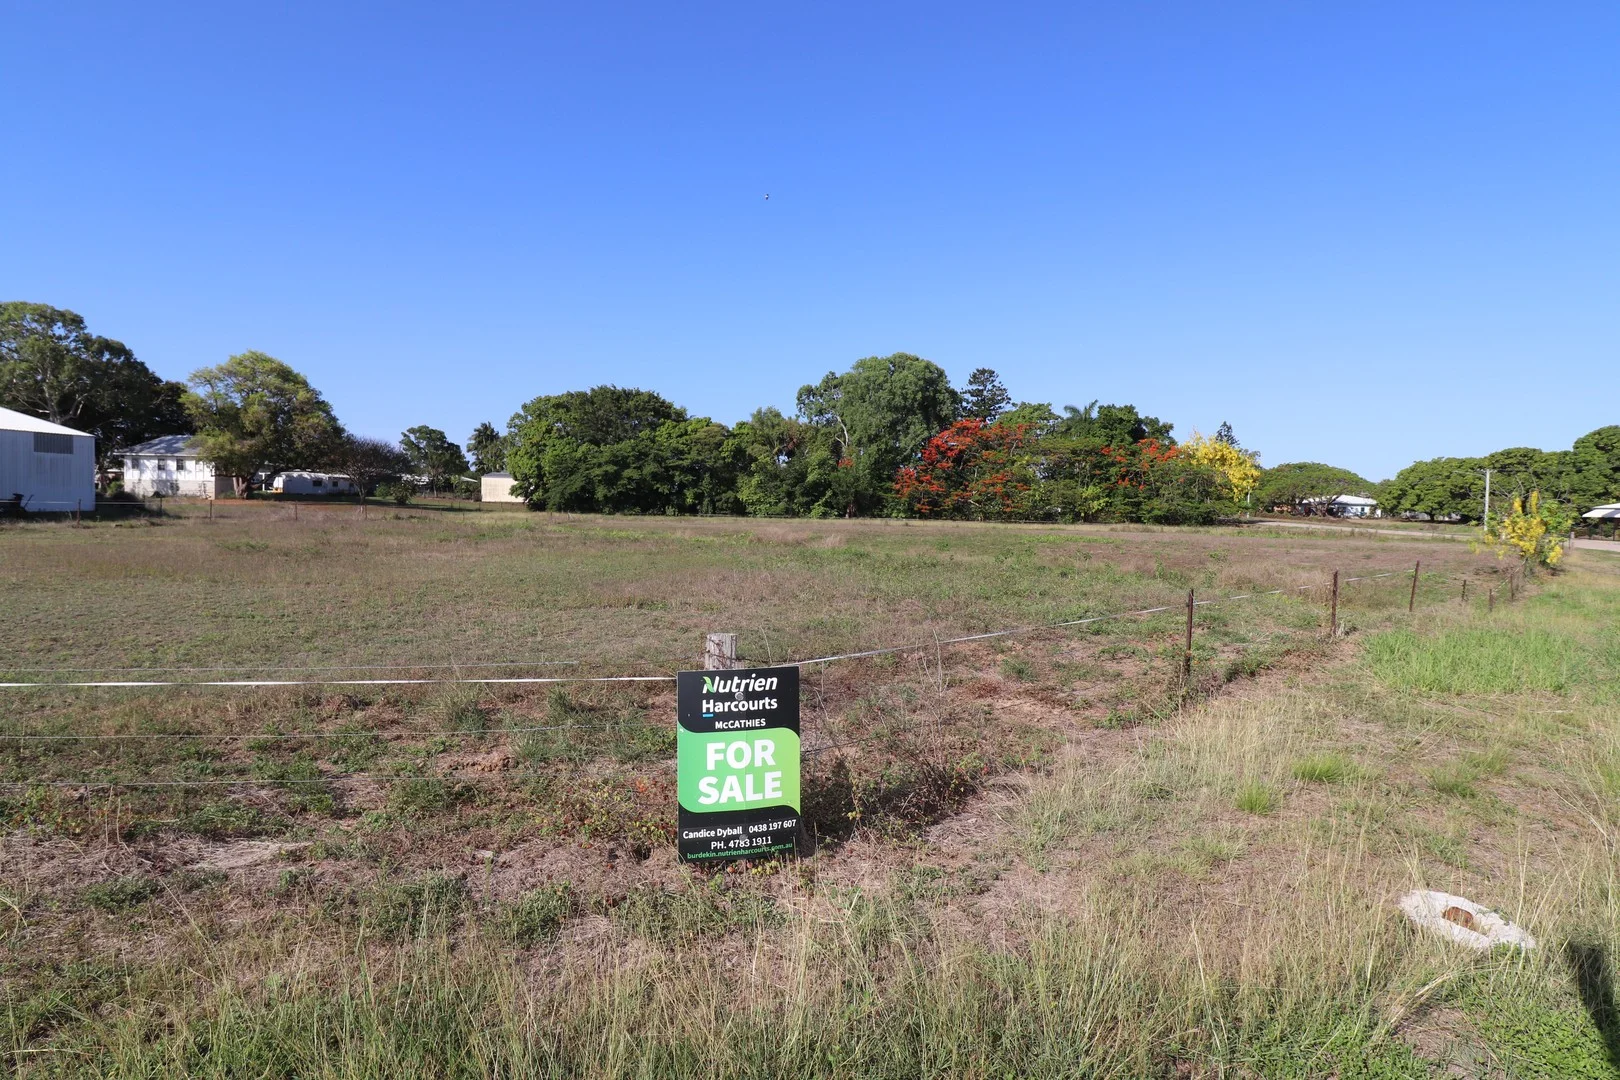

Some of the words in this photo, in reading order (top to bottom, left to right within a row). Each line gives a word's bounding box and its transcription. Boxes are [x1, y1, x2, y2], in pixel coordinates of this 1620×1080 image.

[702, 673, 778, 694] Nutrien
[702, 697, 778, 713] Harcourts
[706, 739, 776, 771] FOR
[697, 770, 783, 805] SALE
[682, 828, 716, 839] Candice
[717, 826, 743, 838] Dyball
[748, 823, 768, 834] 0438
[768, 821, 782, 831] 197
[783, 819, 797, 828] 607
[710, 841, 727, 850] PH.
[728, 839, 750, 849] 4783
[751, 836, 772, 846] 1911
